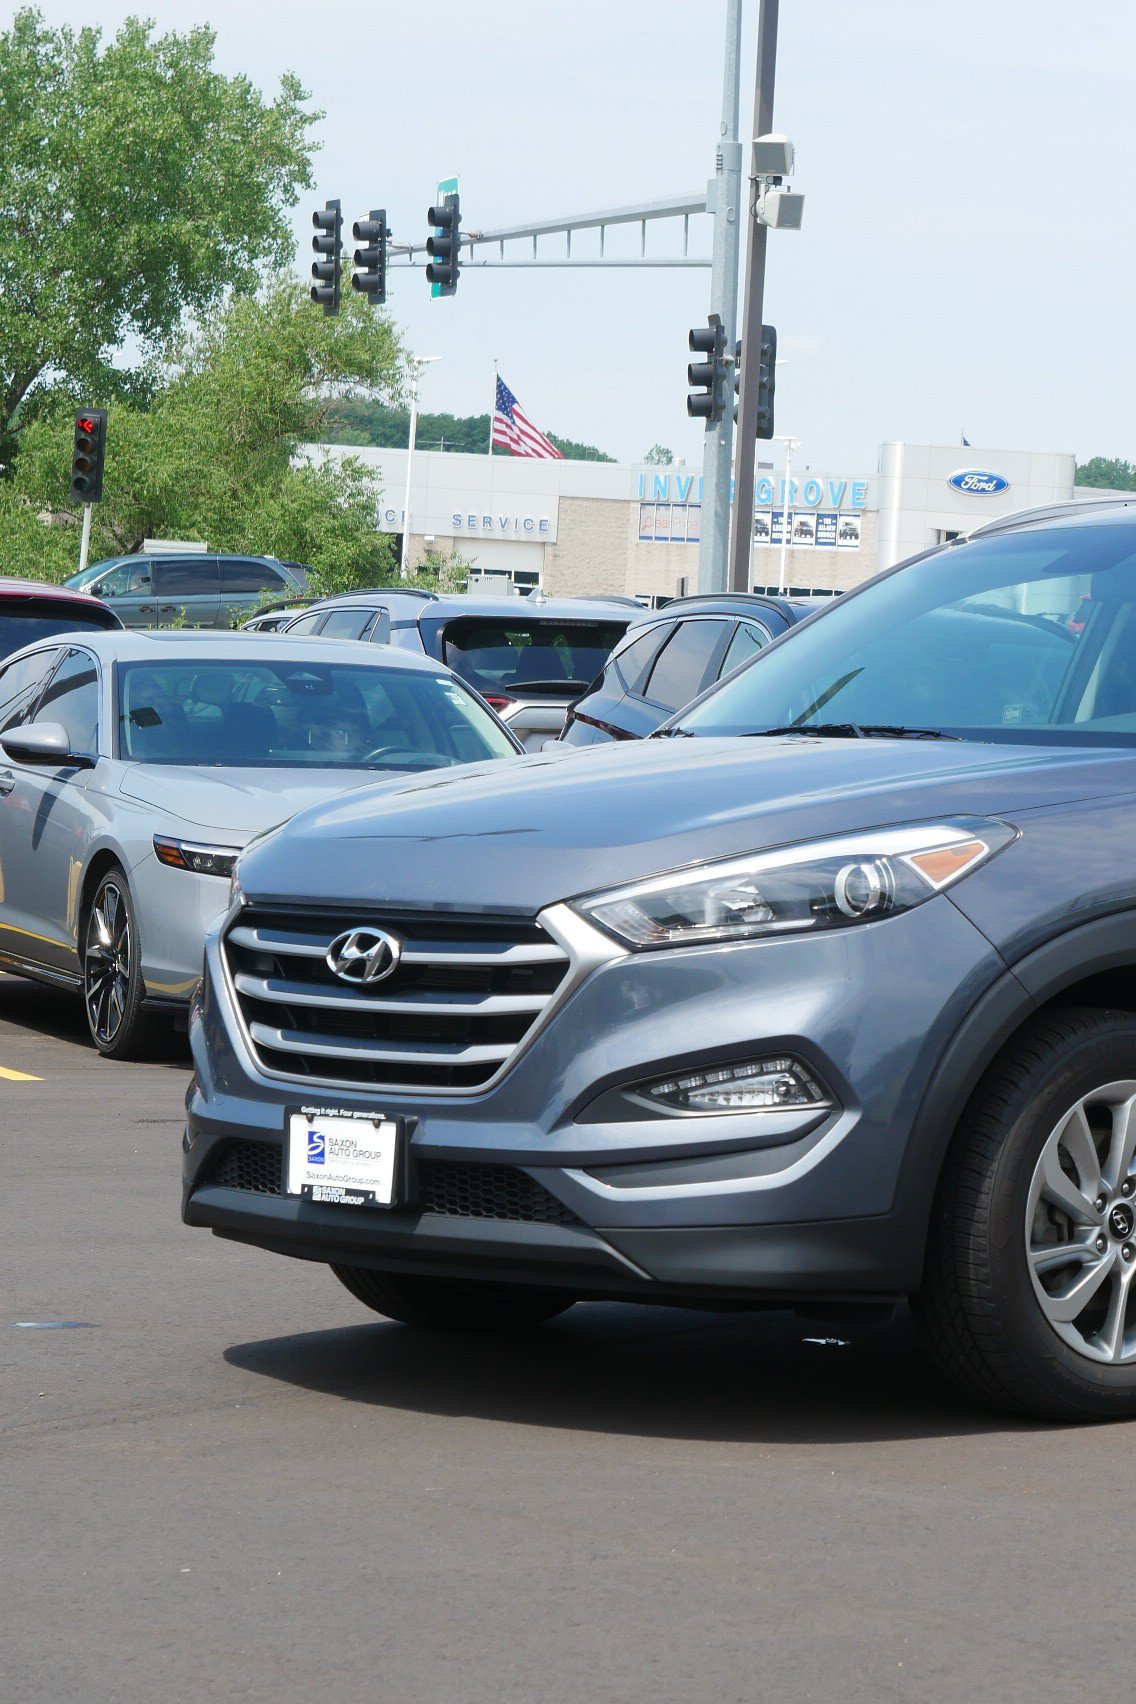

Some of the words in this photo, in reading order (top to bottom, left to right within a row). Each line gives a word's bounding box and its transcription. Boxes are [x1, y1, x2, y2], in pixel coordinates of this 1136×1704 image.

[961, 475, 996, 491] Ford
[639, 473, 736, 503] INV
[755, 477, 866, 508] GROVE
[452, 514, 549, 532] SERVICE
[329, 1138, 357, 1148] SAXON
[329, 1148, 350, 1156] AUTO
[352, 1150, 381, 1159] GROUP
[306, 1171, 380, 1185] SaxonAutoGroup.com
[321, 1187, 345, 1195] SAXON
[340, 1196, 364, 1204] GROUP
